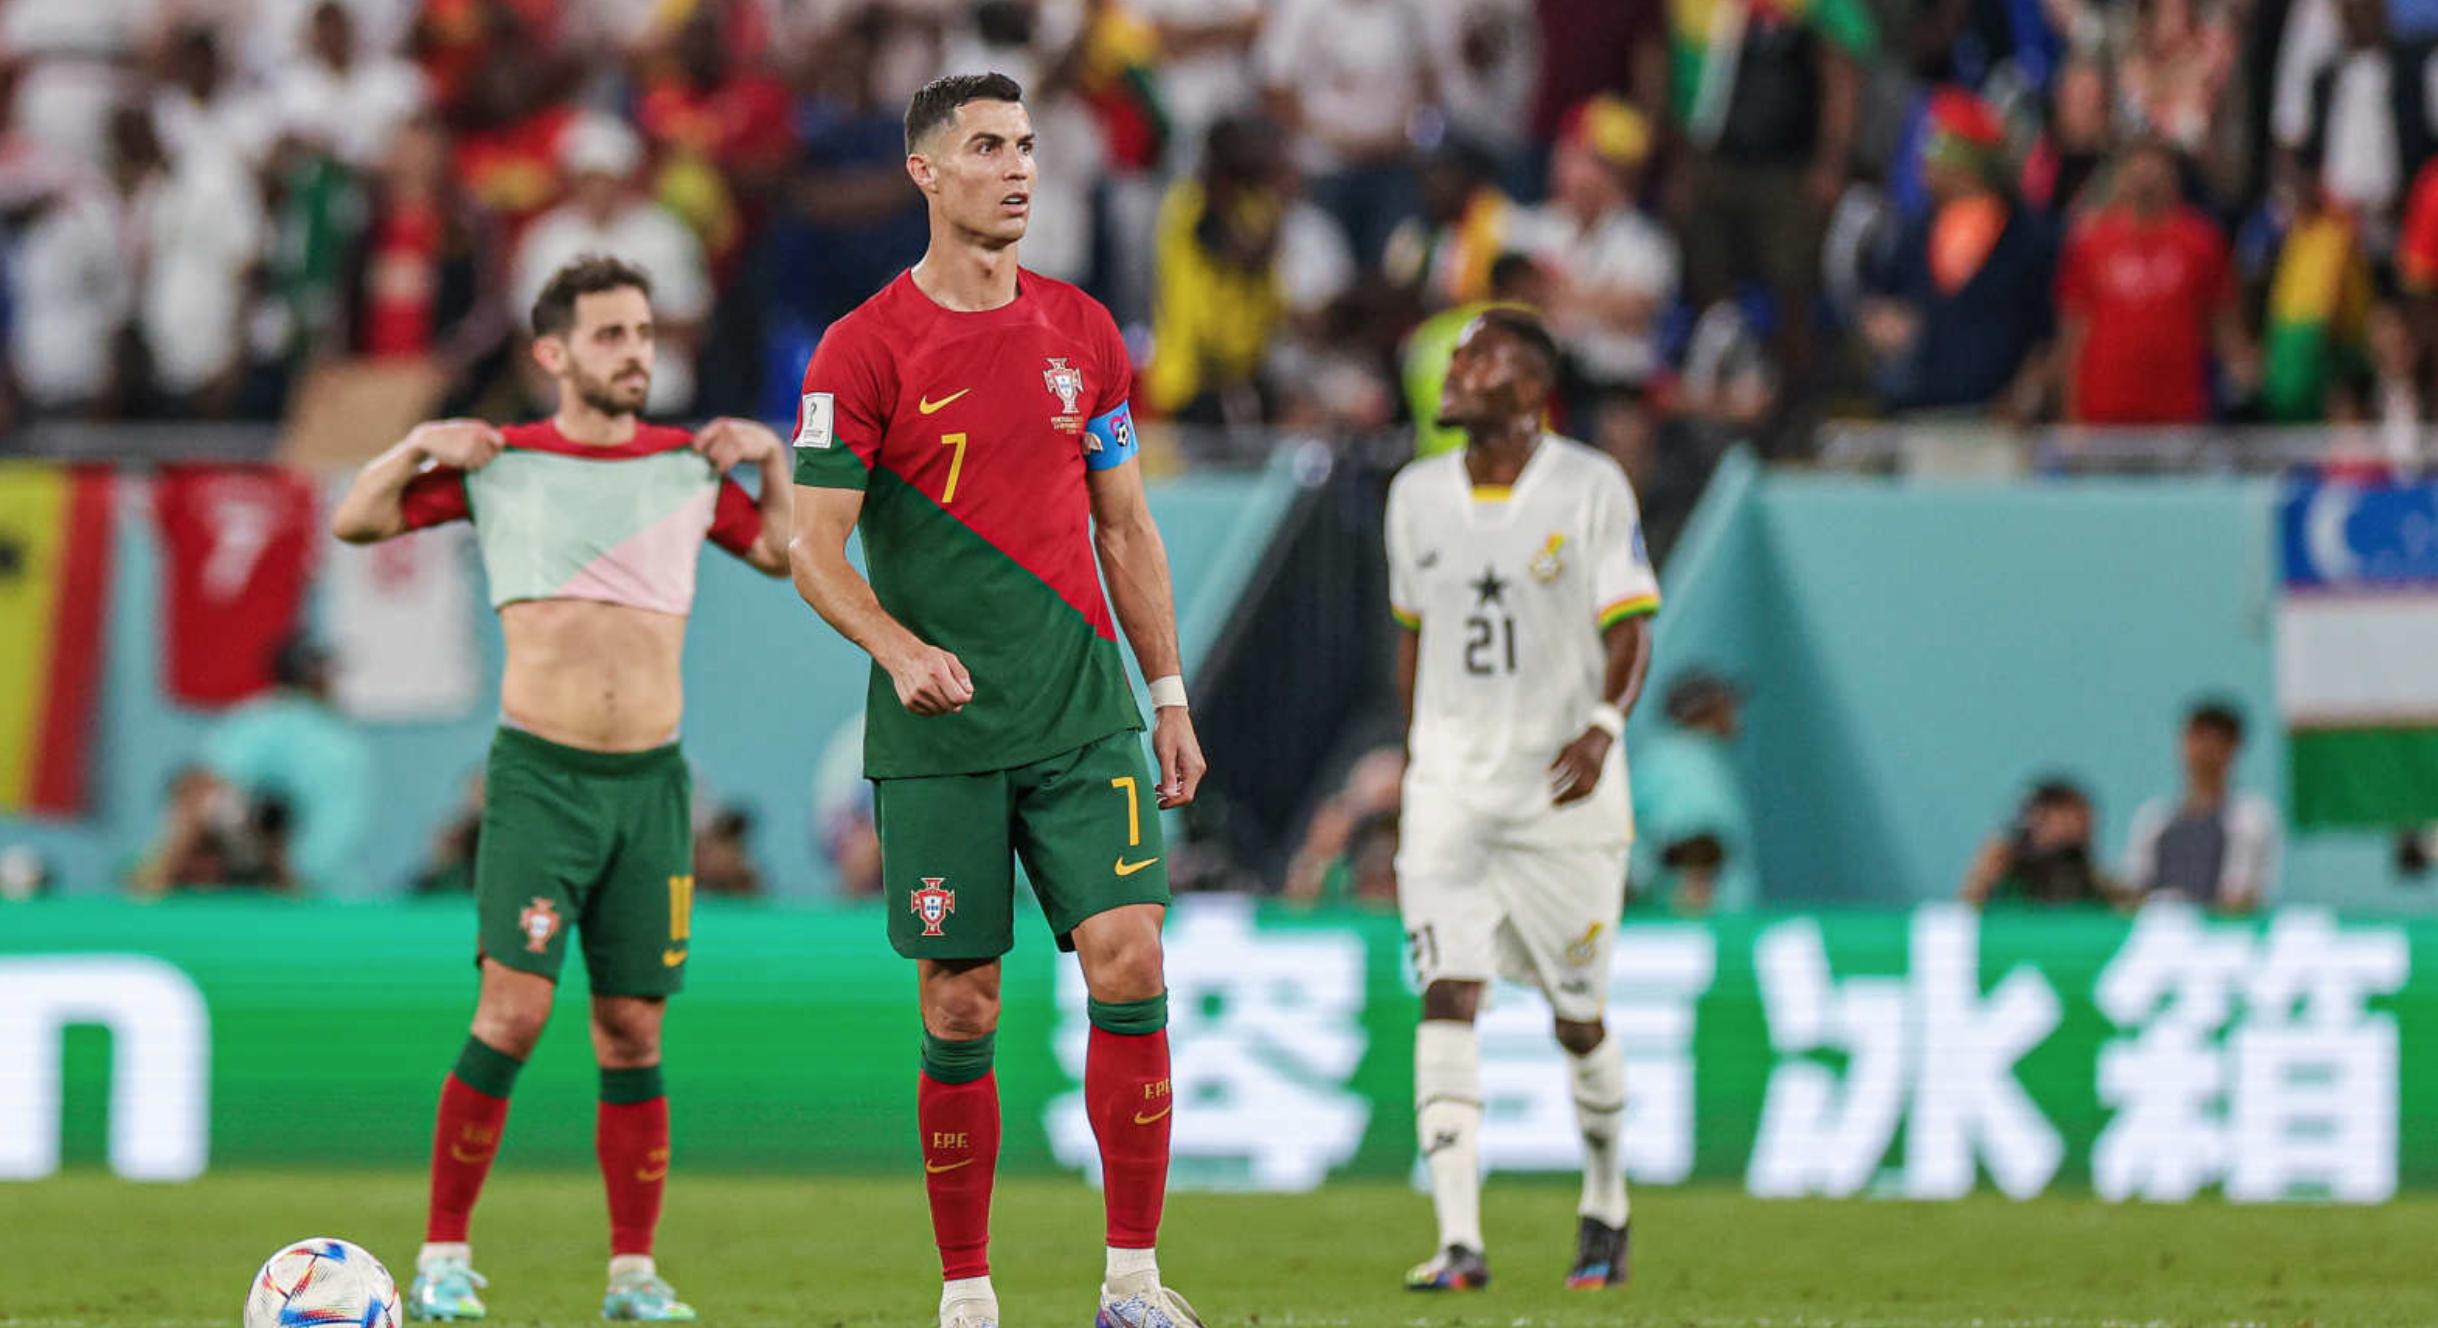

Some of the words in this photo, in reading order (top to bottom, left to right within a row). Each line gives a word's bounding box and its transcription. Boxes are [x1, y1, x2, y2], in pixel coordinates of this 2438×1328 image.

[941, 432, 967, 503] 7
[1465, 616, 1516, 676] 21
[1111, 776, 1139, 846] 7
